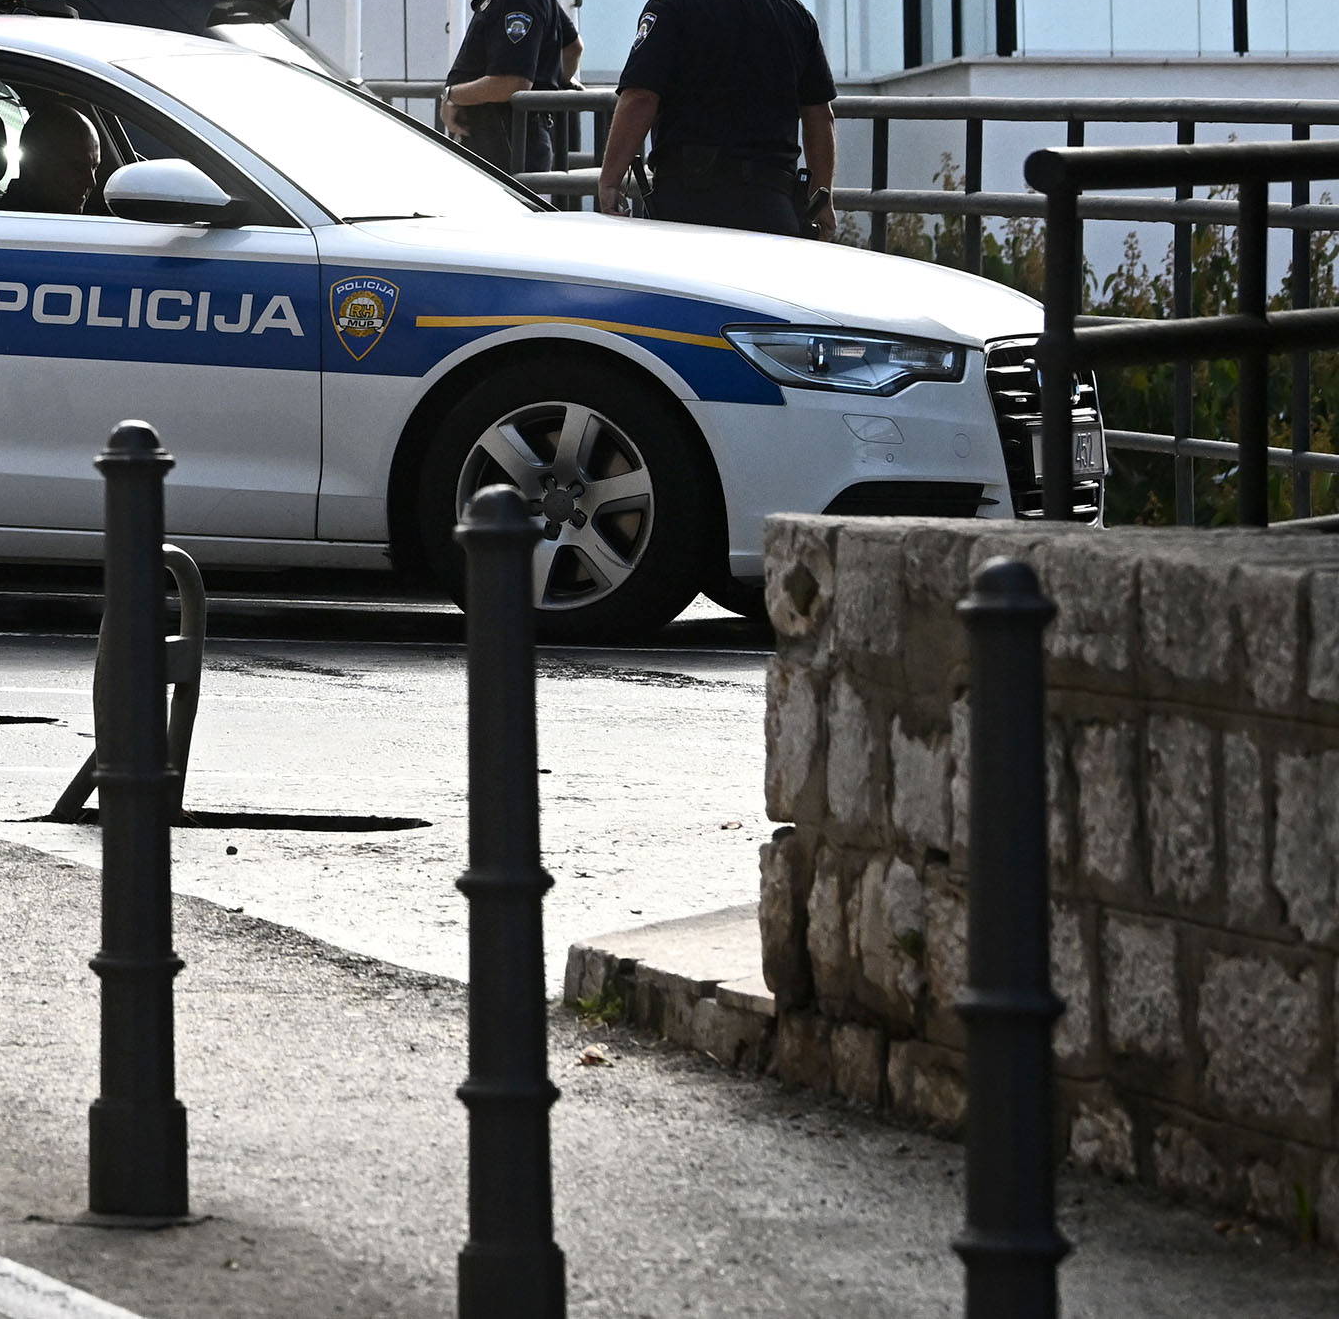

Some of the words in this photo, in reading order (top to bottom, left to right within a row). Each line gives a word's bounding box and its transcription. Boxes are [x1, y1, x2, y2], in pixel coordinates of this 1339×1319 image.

[336, 280, 395, 298] POLICIJA
[349, 303, 375, 318] RH
[347, 319, 375, 328] MUP
